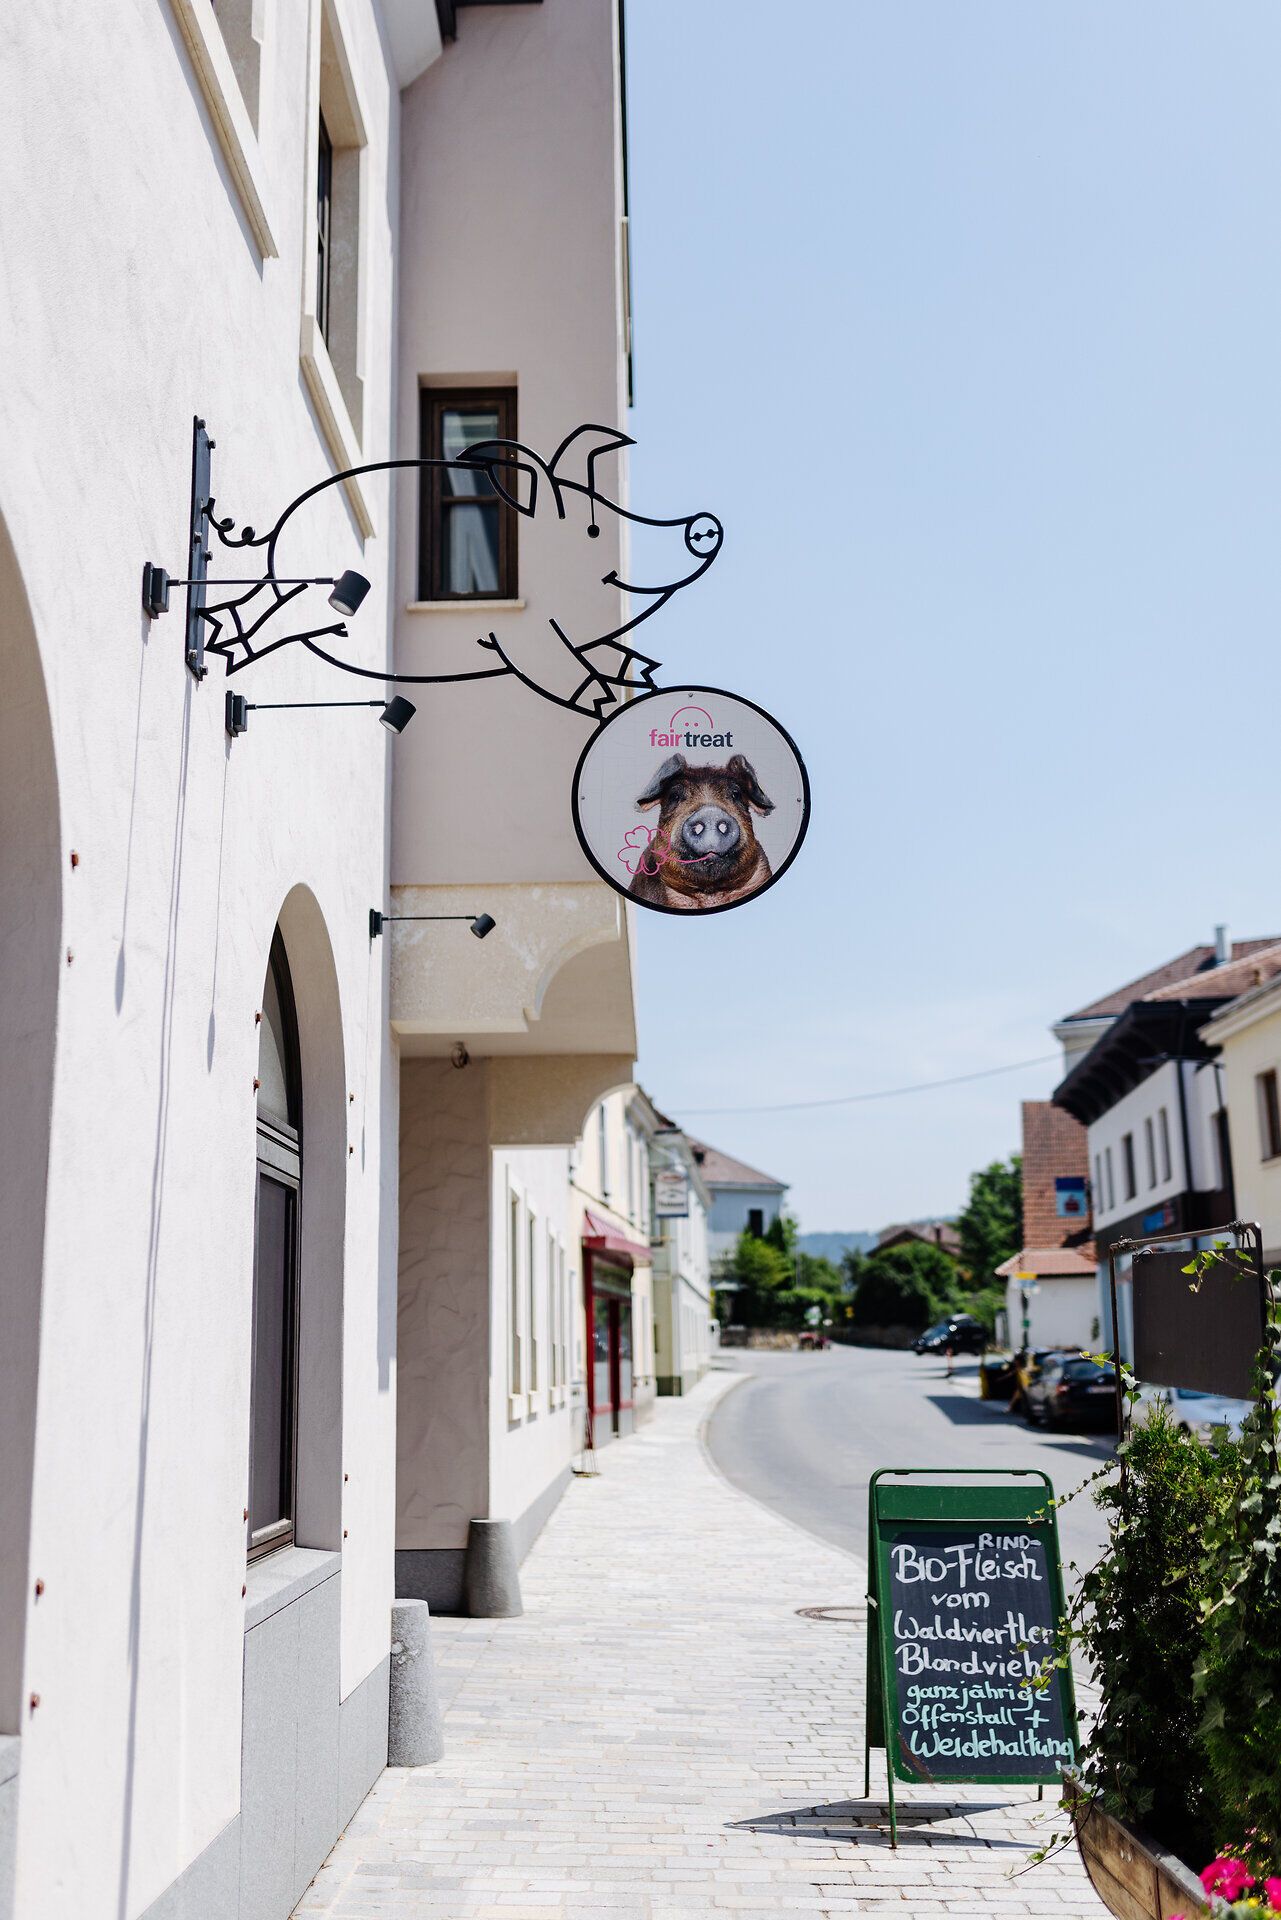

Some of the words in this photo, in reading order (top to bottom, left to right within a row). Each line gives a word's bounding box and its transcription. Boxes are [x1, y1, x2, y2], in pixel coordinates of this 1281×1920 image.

[931, 1591, 990, 1610] vom
[893, 1610, 1054, 1645] Waldviertler
[895, 1642, 1042, 1679] Blondvieh
[902, 1702, 1016, 1730] Offenstall
[1024, 1710, 1050, 1728] +
[910, 1728, 1075, 1770] Weidehaltung
